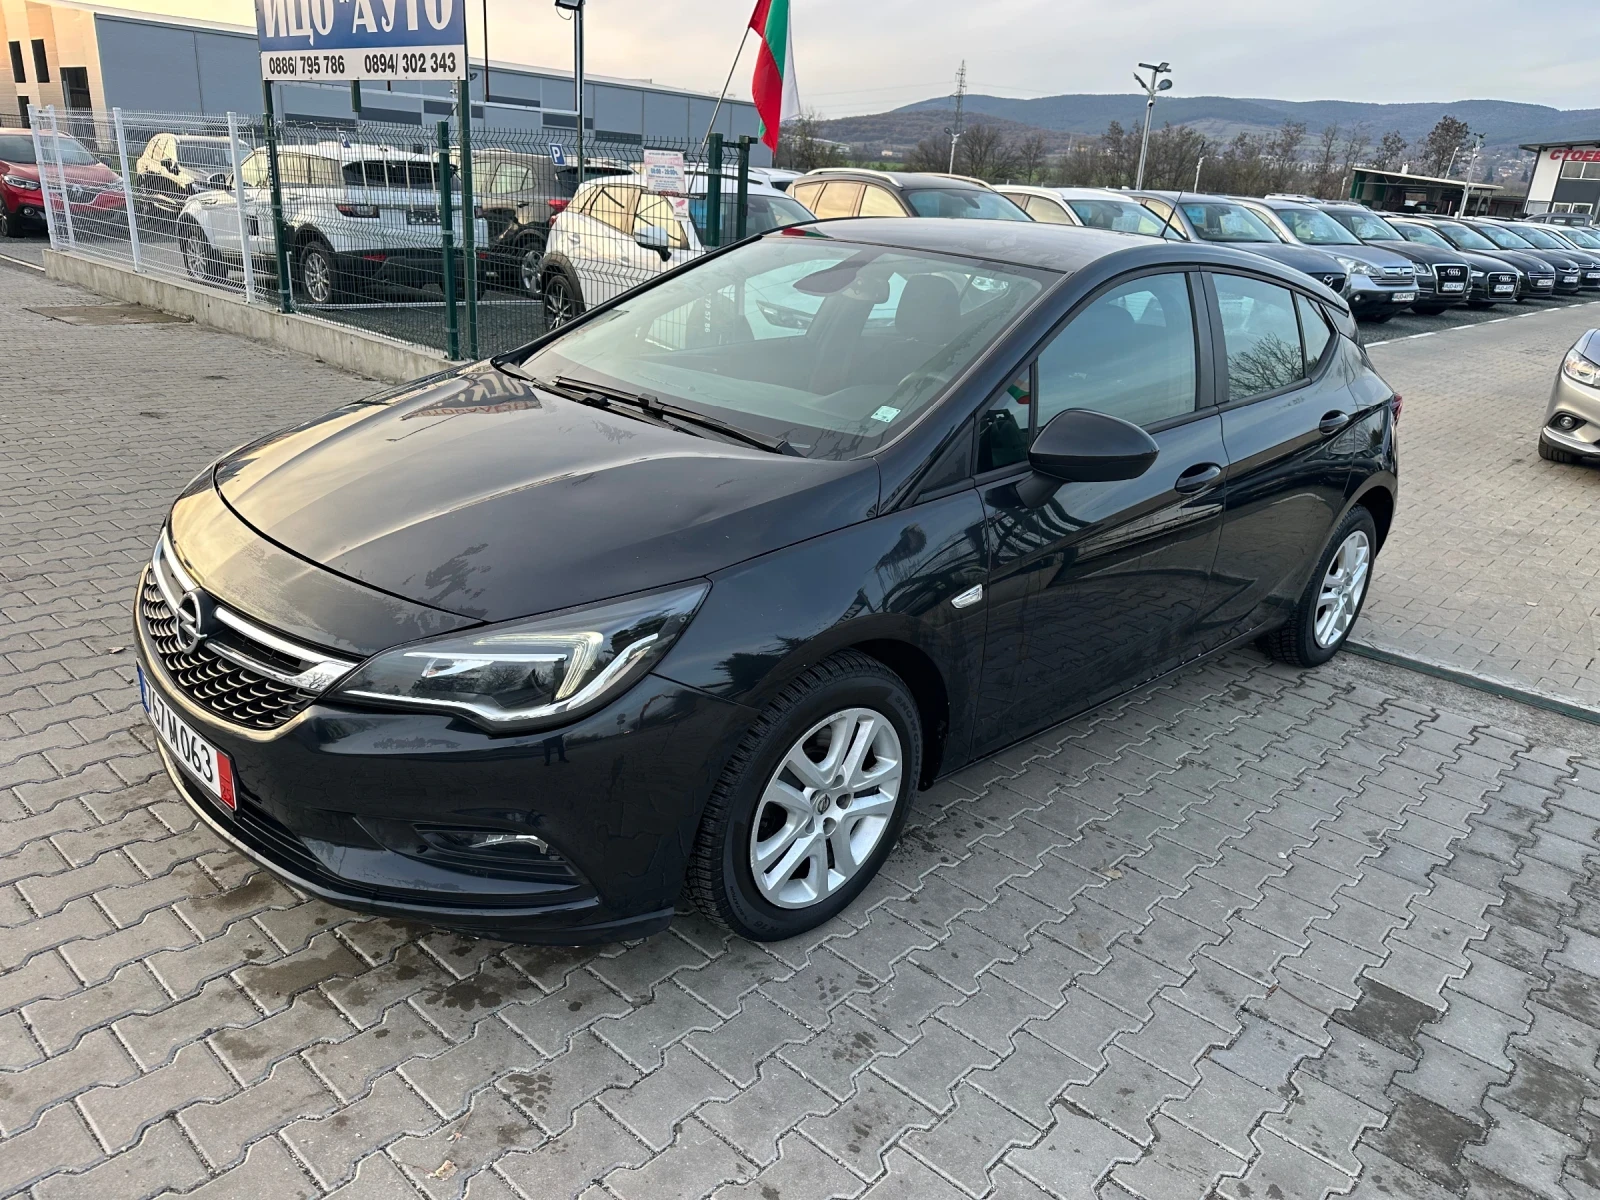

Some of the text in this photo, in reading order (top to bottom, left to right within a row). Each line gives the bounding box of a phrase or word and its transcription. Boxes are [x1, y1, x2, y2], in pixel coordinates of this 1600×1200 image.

[300, 56, 320, 74] 795
[323, 55, 345, 74] 786
[364, 53, 398, 75] 0894/
[402, 53, 426, 73] 302
[430, 52, 456, 73] 343
[551, 146, 561, 163] P
